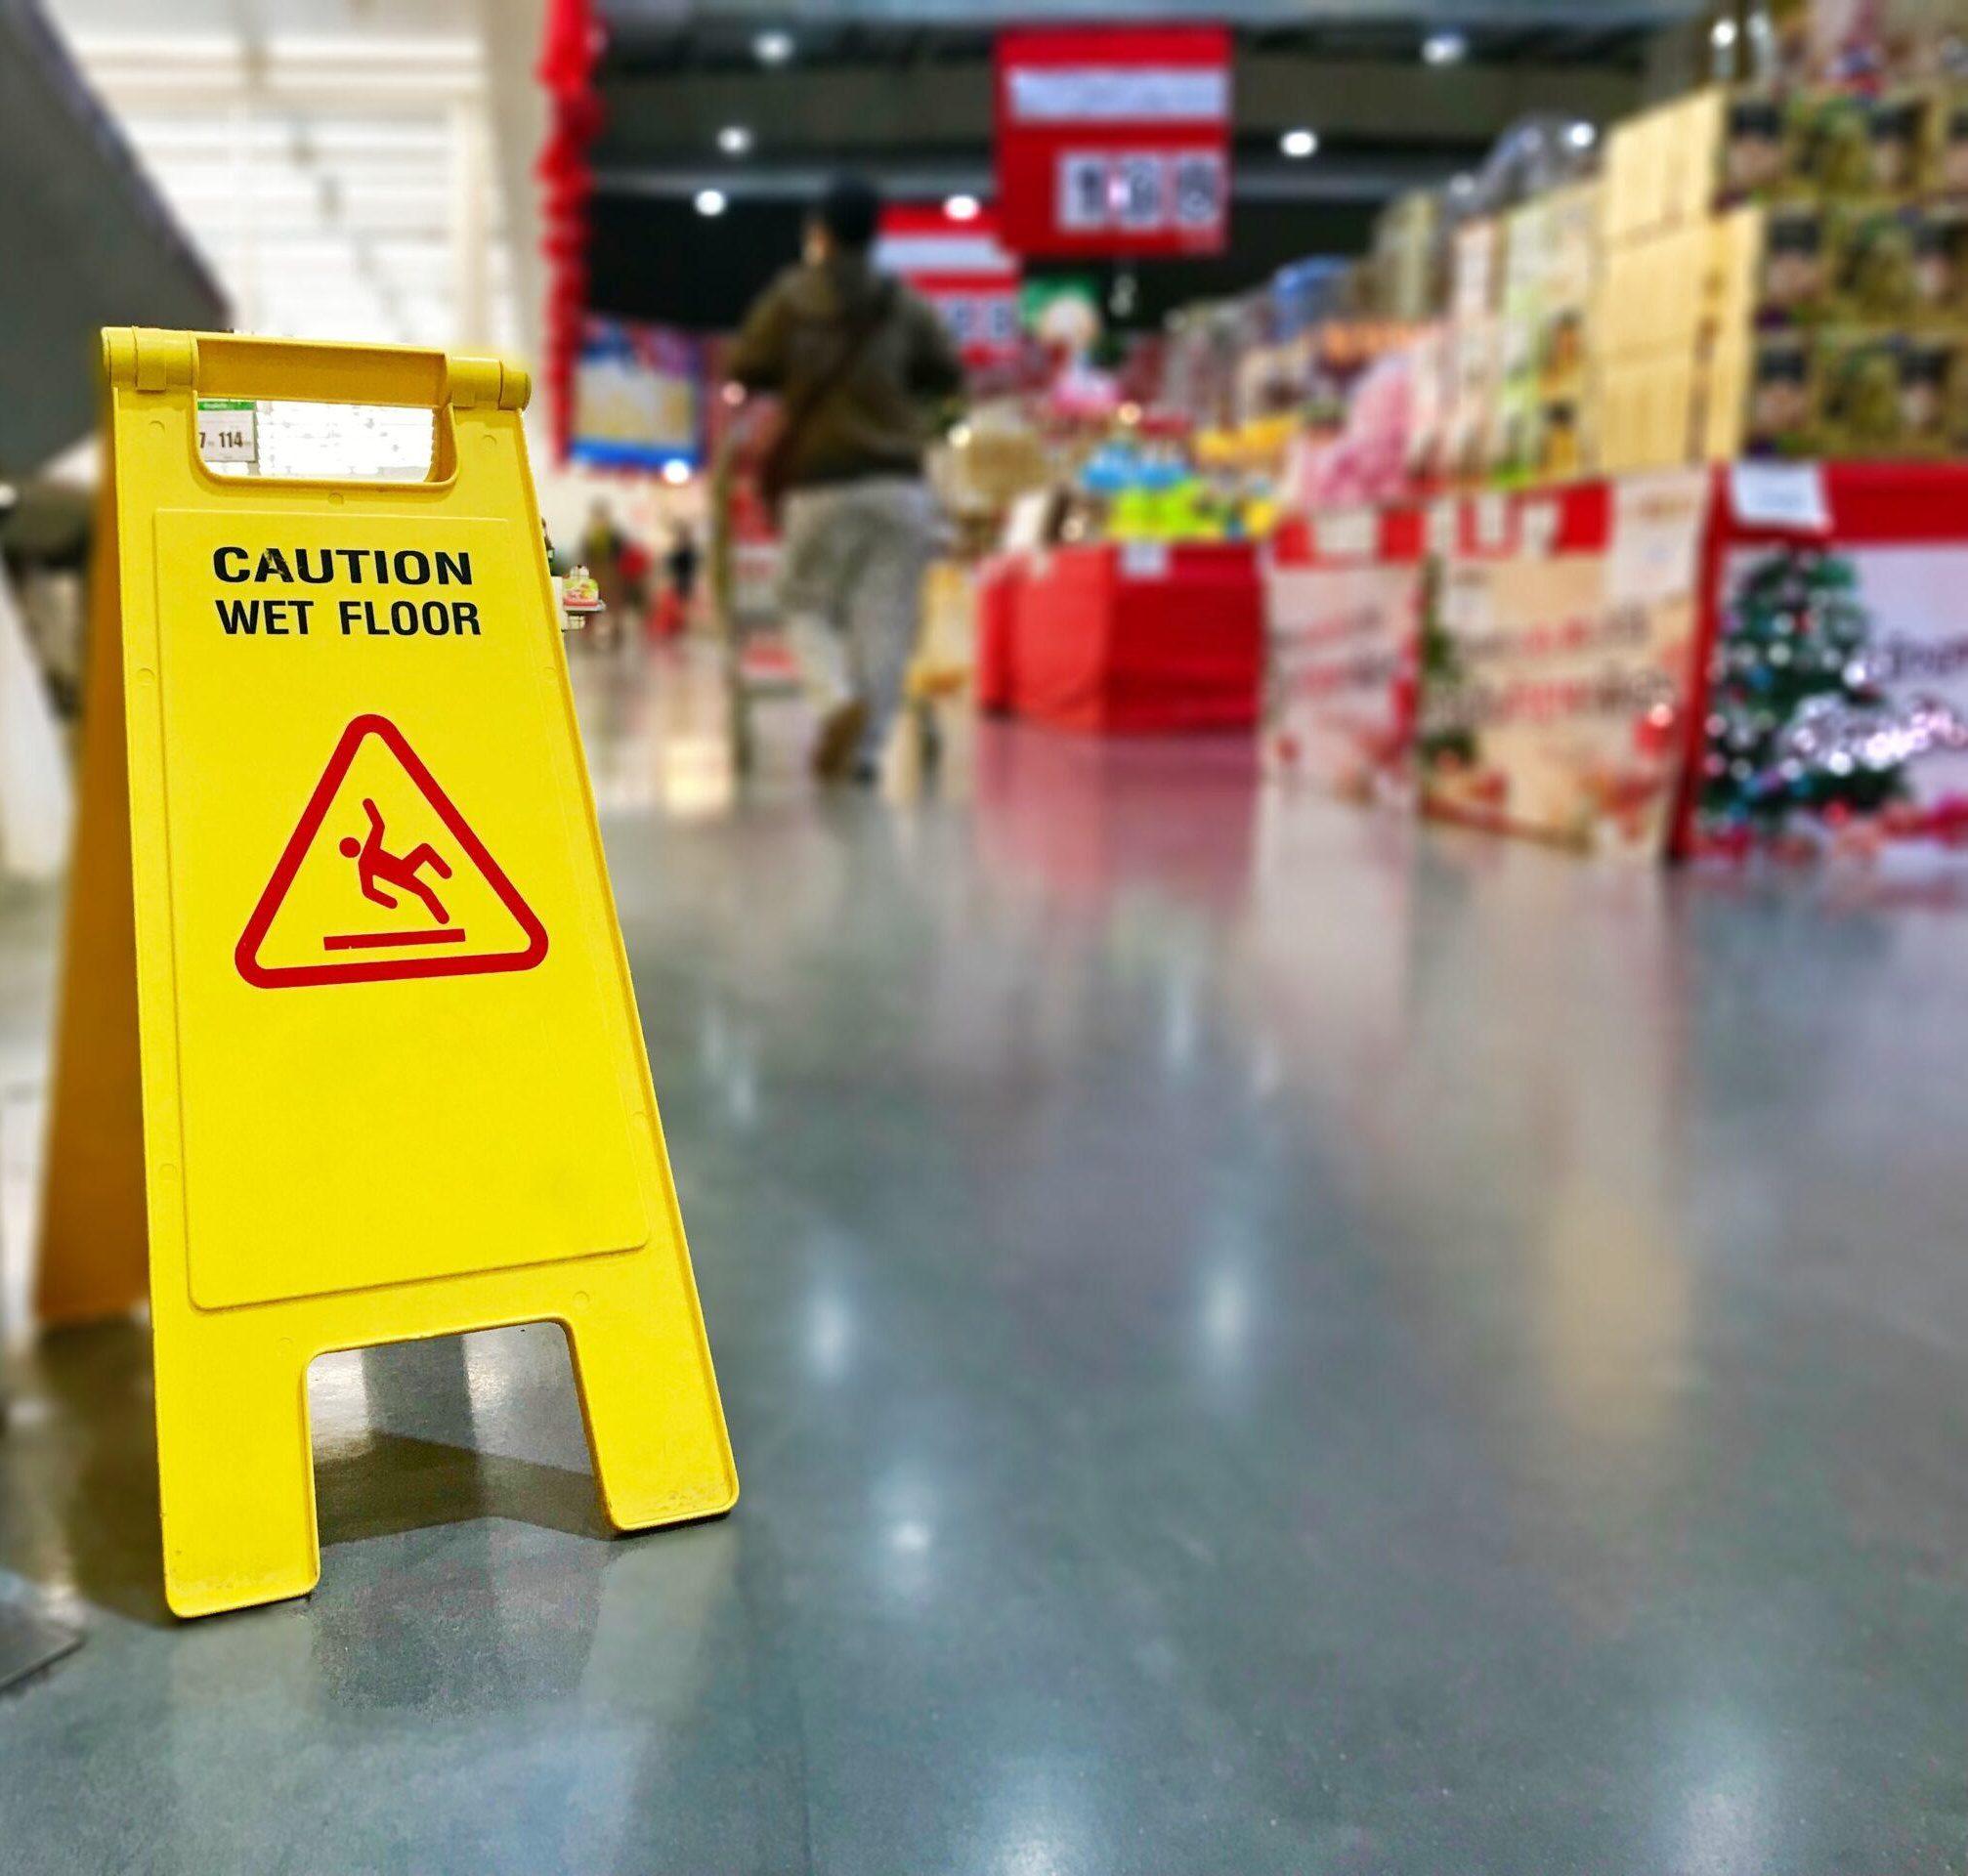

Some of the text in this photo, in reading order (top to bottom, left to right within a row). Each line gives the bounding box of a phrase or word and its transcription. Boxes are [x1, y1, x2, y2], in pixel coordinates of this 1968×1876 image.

[218, 431, 244, 448] 114
[213, 546, 473, 585] CAUTION
[215, 599, 481, 636] WET FLOOR
